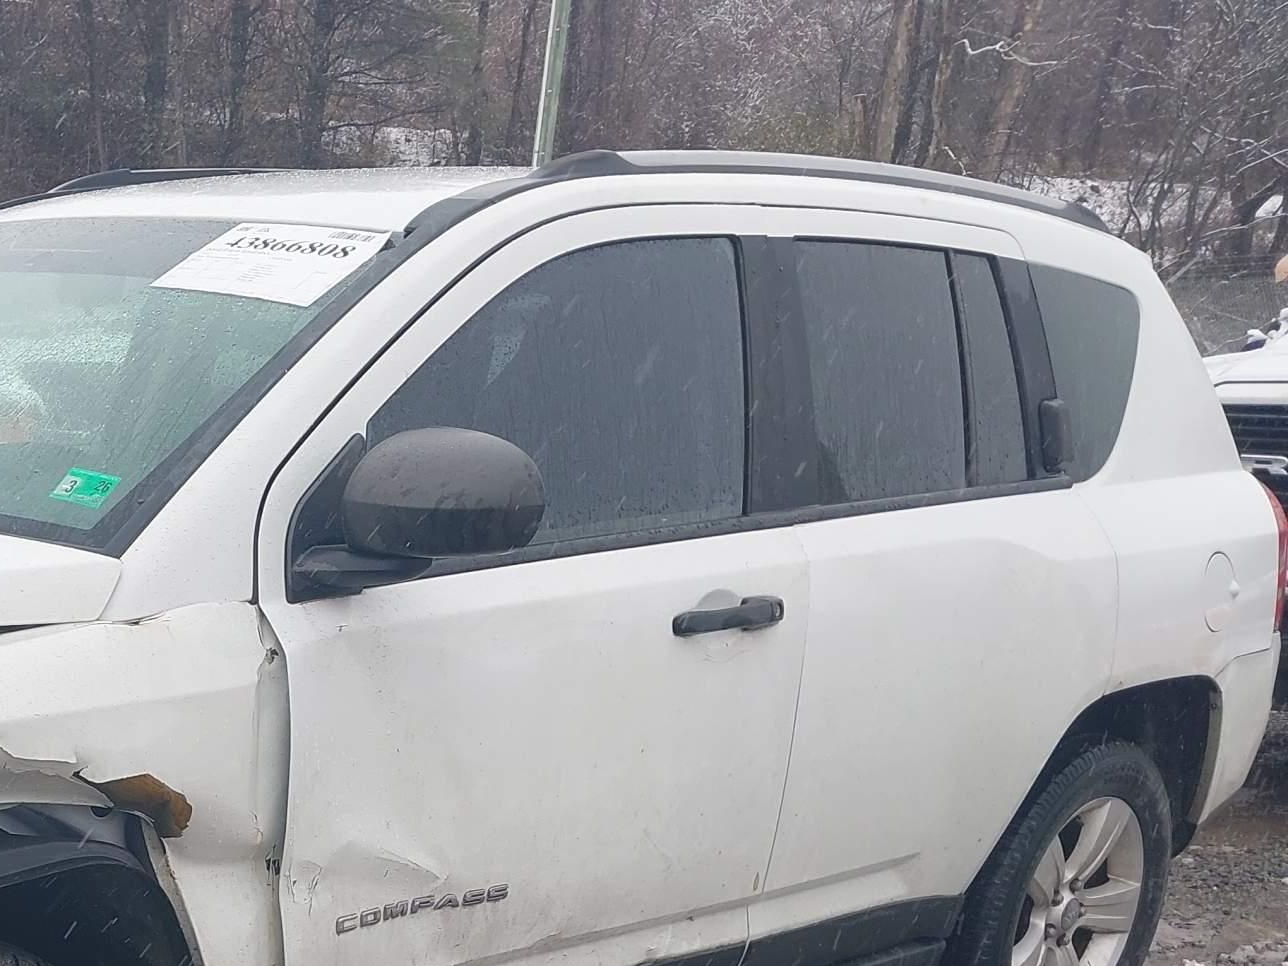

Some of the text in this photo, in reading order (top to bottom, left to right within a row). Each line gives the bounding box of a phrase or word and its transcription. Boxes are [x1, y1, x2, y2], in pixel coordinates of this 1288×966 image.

[225, 236, 357, 259] 43866808
[65, 480, 113, 494] 3 26
[336, 884, 509, 935] COMPASS
